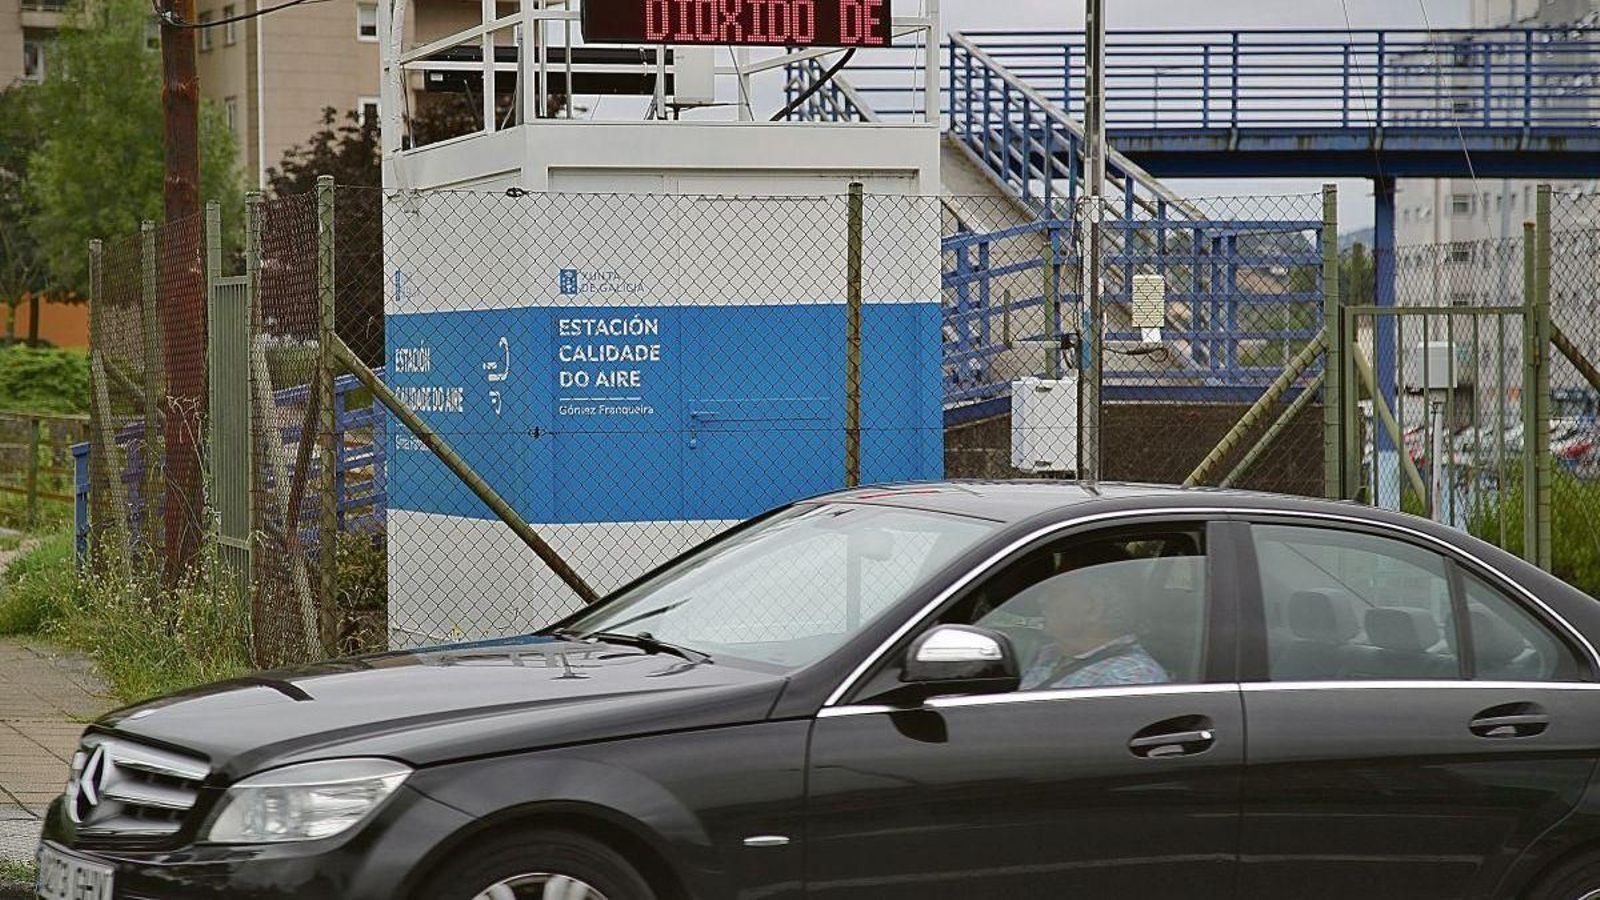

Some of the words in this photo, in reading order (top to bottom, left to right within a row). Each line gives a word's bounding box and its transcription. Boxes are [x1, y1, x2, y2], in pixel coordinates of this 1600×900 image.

[646, 0, 814, 42] DIOXIDO
[840, 0, 883, 44] DE
[581, 283, 596, 293] DE
[559, 314, 658, 336] ESTACIÓN
[559, 344, 661, 362] CALIDADE
[559, 370, 590, 388] DO
[595, 370, 641, 388] AIRE
[559, 405, 596, 415] Gómez
